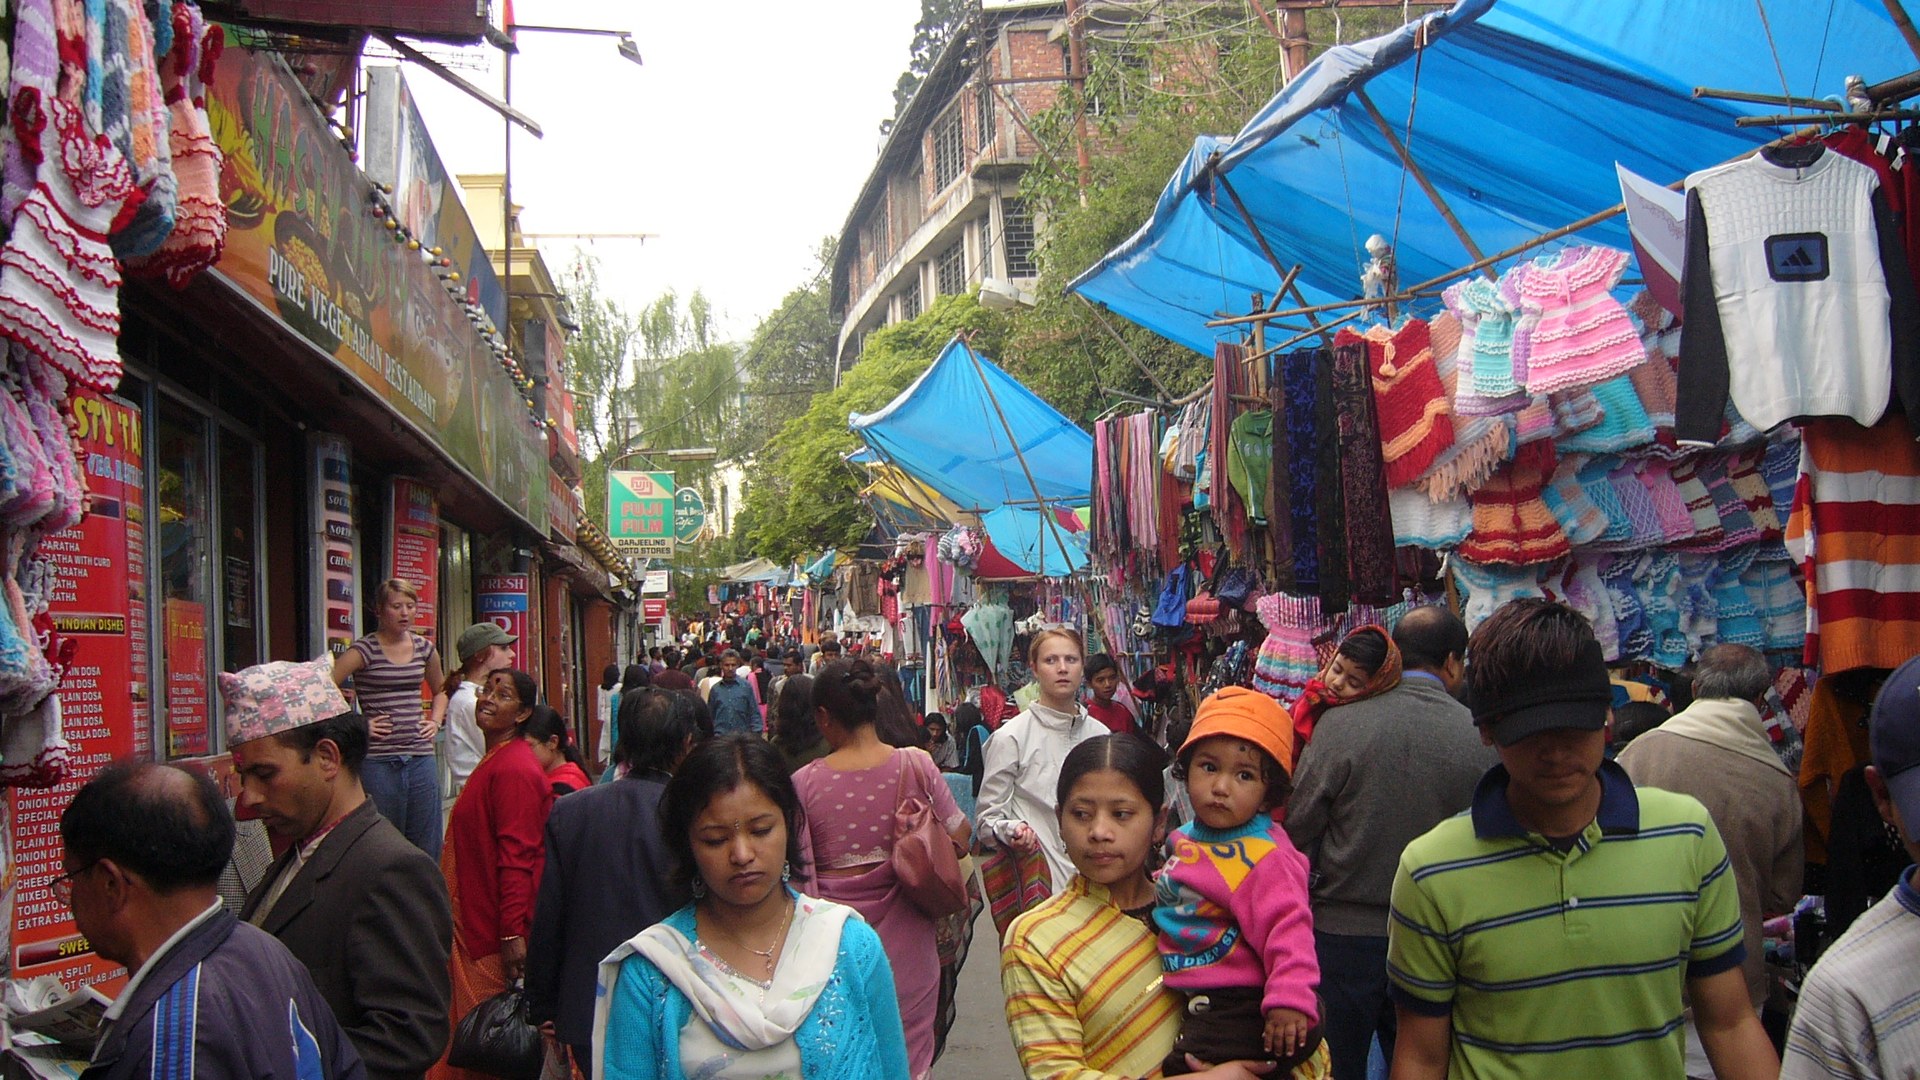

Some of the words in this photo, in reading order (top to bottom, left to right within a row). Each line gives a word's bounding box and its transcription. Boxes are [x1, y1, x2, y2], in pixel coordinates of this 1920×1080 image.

[268, 246, 306, 312] PURE
[311, 284, 383, 374] VEGETARIAN
[384, 352, 437, 423] RESTAURANT
[622, 502, 663, 517] FUJI
[622, 519, 663, 534] FILM
[618, 538, 666, 547] DARJEELING
[640, 546, 671, 555] STORES
[74, 555, 93, 567] WITH
[481, 578, 524, 590] FRESH
[485, 597, 516, 609] Pure
[62, 616, 97, 631] INDIAN
[98, 618, 124, 632] DISHES
[80, 666, 101, 677] DOSA
[76, 678, 97, 690] DOSA
[82, 690, 103, 702] DOSA
[83, 702, 104, 714] DOSA
[83, 715, 104, 727] DOSA
[91, 727, 112, 739] DOSA
[92, 752, 112, 764] DOSA
[17, 797, 49, 811] ONION
[17, 809, 59, 824] SPECIAL
[16, 825, 39, 837] IDLY
[15, 838, 45, 850] PLAIN
[15, 850, 47, 863] ONION
[15, 862, 47, 877] ONION
[17, 889, 48, 903] MIXED
[17, 900, 59, 916] TOMATO
[17, 915, 52, 930] EXTRA
[1183, 945, 1220, 968] DEEP
[66, 963, 93, 979] SPLIT
